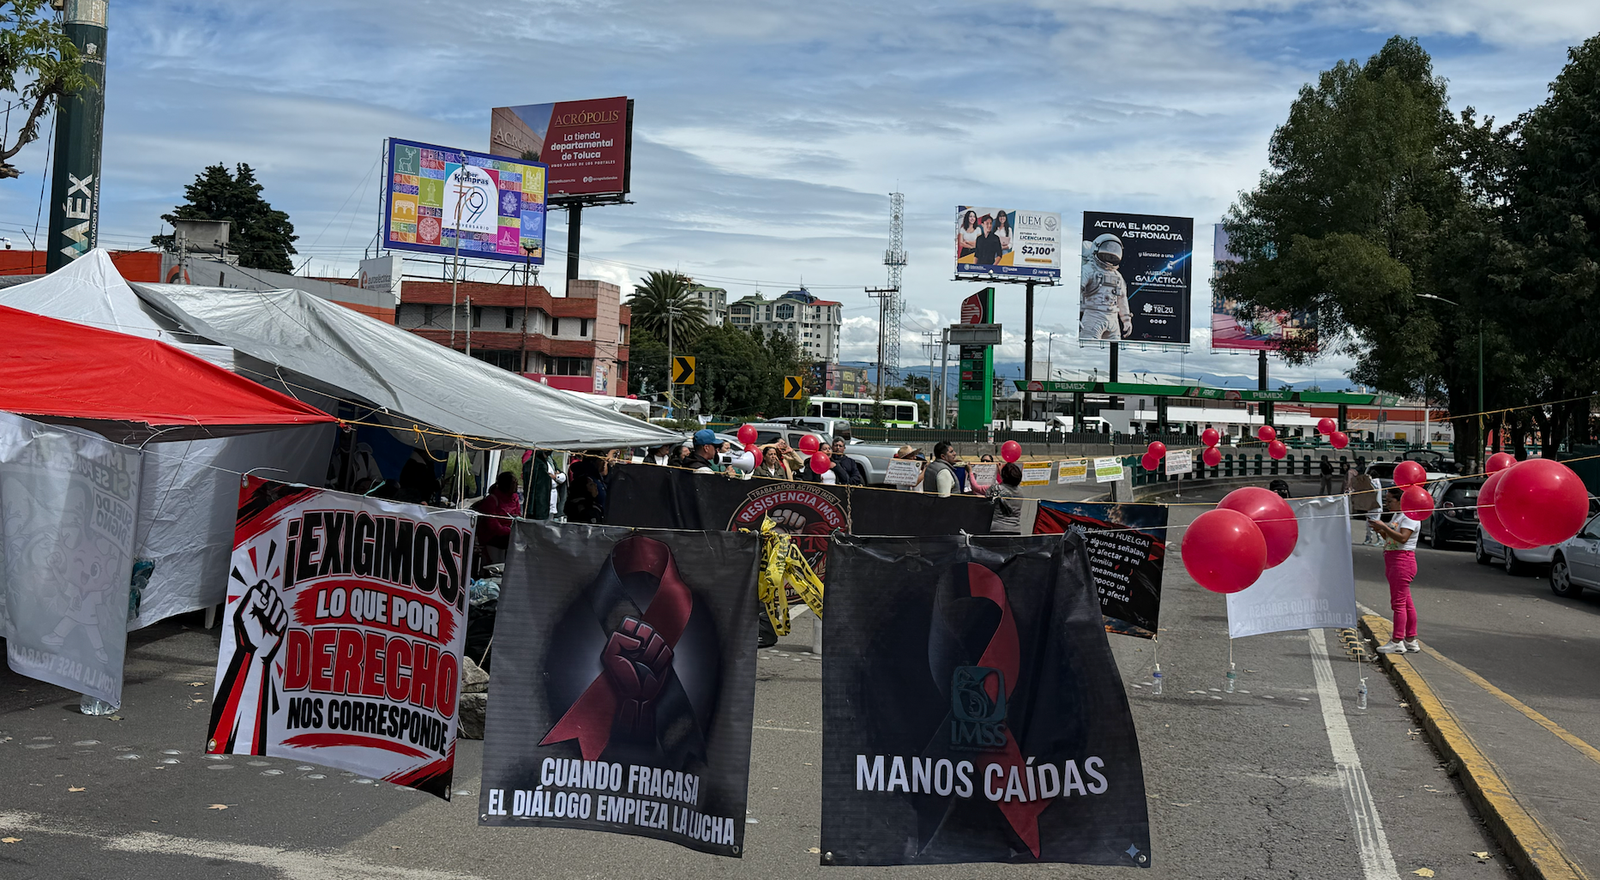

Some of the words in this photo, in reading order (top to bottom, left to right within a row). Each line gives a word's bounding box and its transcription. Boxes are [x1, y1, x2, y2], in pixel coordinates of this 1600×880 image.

[554, 110, 618, 126] ACRÓPOLIS
[564, 133, 573, 141] La
[574, 131, 600, 140] tienda
[551, 139, 613, 152] departamental
[561, 152, 572, 161] de
[573, 151, 601, 160] Toluca
[454, 173, 489, 185] Kompras
[453, 184, 488, 224] 79
[1018, 215, 1041, 226] IUEM
[1094, 220, 1126, 229] ACTIVA
[1142, 223, 1170, 232] MODO
[1122, 231, 1183, 241] ASTRONAUTA
[752, 484, 796, 498] TRABAJADOR
[797, 484, 820, 495] ACTIVO
[821, 490, 836, 502] IMSS
[741, 492, 816, 522] RESISTENCIA
[817, 501, 840, 525] IMSS
[1090, 537, 1116, 550] algunos
[1118, 544, 1146, 559] señalan,
[1116, 533, 1150, 548] HUELGA!
[282, 509, 472, 616] ¡EXIGIMOS!
[1090, 556, 1114, 568] familia
[1097, 549, 1122, 560] afectar
[1094, 576, 1115, 588] mpoco
[1117, 584, 1126, 592] un
[1107, 591, 1130, 603] afecte
[315, 588, 346, 619] LO
[350, 588, 388, 622] QUE
[391, 594, 440, 637] POR
[283, 628, 458, 719] DERECHO
[287, 697, 323, 730] NOS
[327, 699, 448, 756] CORRESPONDE
[951, 721, 1007, 746] IMSS
[541, 757, 623, 792] CUANDO
[627, 765, 700, 806] FRACASA
[856, 754, 974, 798] MANOS
[984, 756, 1108, 803] CAÍDAS
[488, 788, 507, 816] EL
[513, 785, 591, 820] DIÁLOGO
[597, 795, 668, 830] EMPIEZA
[672, 805, 688, 835] LA
[688, 809, 735, 846] LUCHA
